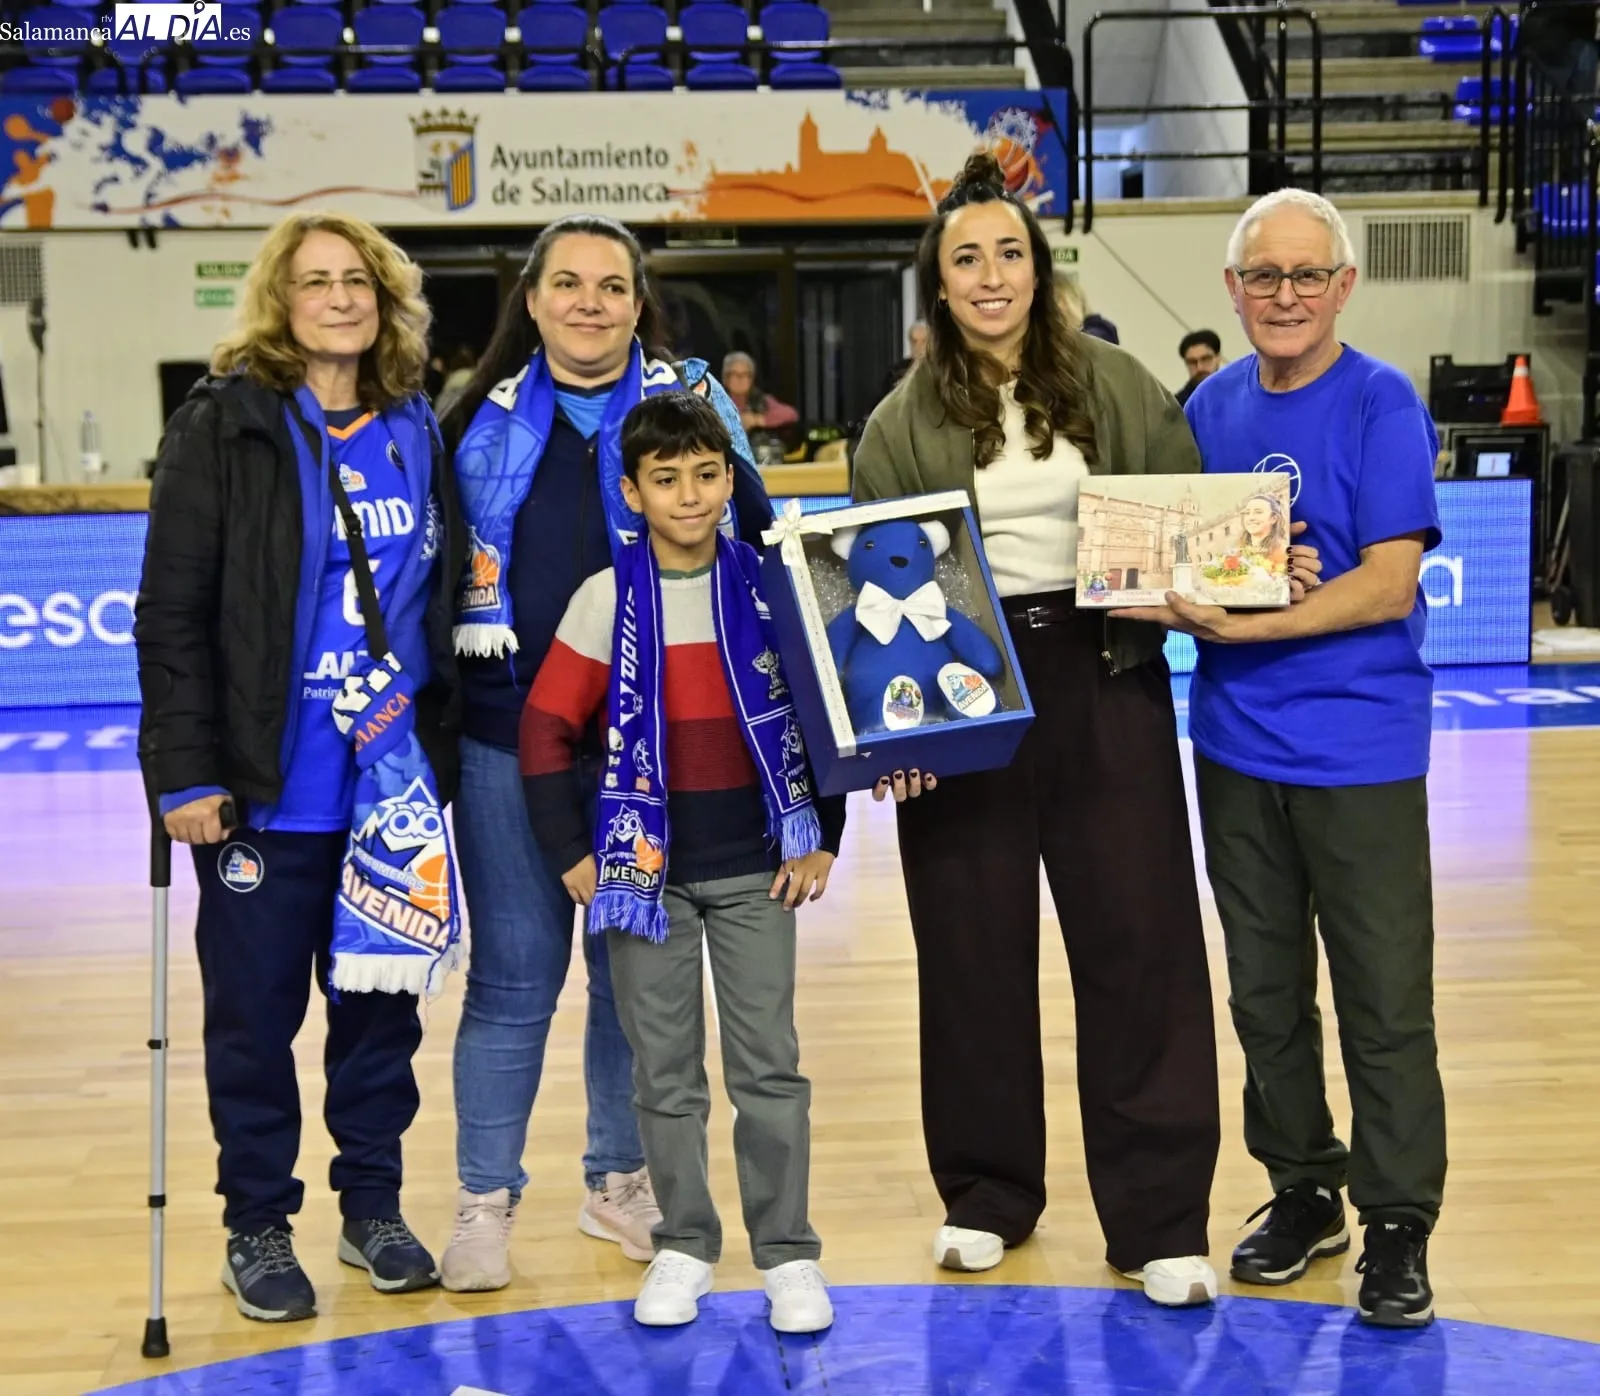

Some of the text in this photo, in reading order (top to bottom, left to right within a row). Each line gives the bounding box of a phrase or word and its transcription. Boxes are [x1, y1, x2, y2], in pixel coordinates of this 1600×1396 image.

[490, 142, 670, 175] Ayuntamiento
[491, 177, 672, 205] de Salamanca
[604, 865, 660, 888] AVENIDA
[342, 862, 450, 951] AVENIDA
